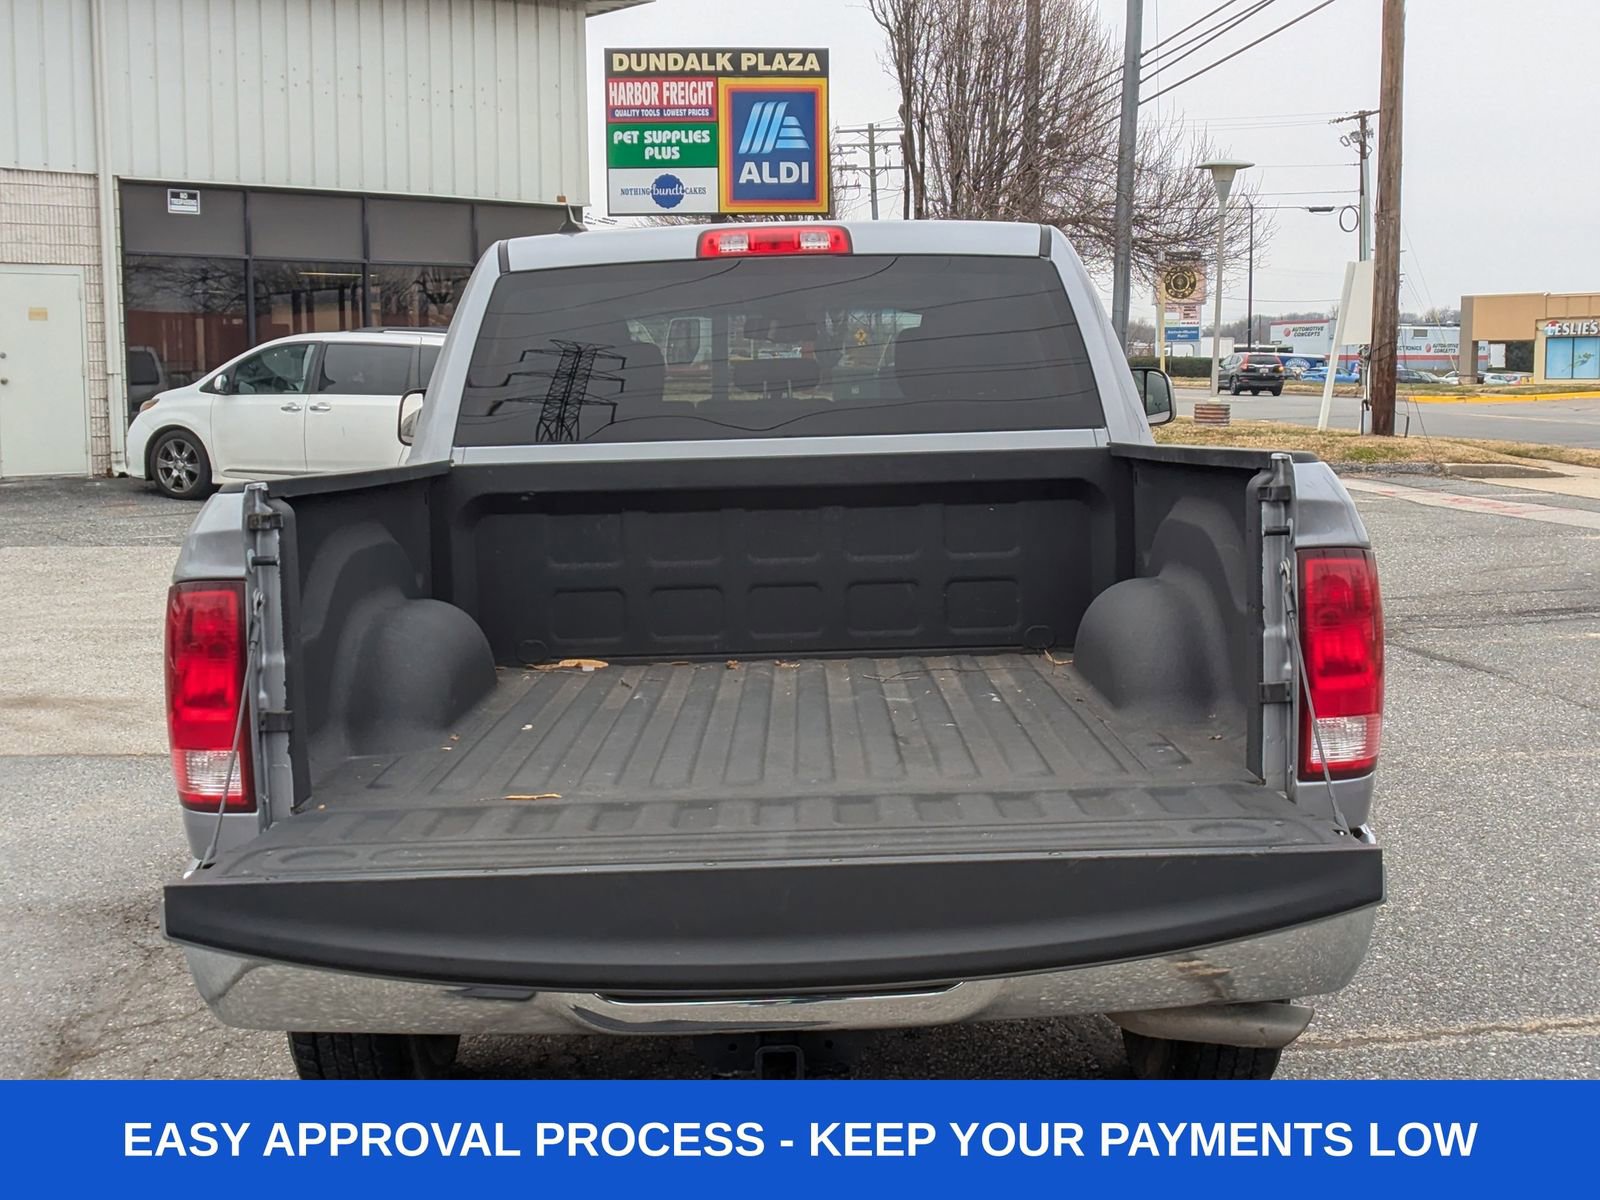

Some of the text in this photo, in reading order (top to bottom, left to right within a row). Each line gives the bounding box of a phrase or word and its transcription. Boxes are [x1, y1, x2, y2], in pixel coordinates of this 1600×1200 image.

[612, 53, 821, 72] DUNDALK PLAZA
[609, 81, 714, 106] HARBOR FREIGHT
[614, 108, 710, 117] QUALITY TOOLS LOWEST PRICES
[613, 130, 711, 144] PET SUPPLIES
[644, 146, 681, 160] PLUS
[739, 161, 810, 184] ALDI
[620, 183, 707, 196] NOTHING bundt CAKES
[1546, 320, 1599, 336] LESLIE'S
